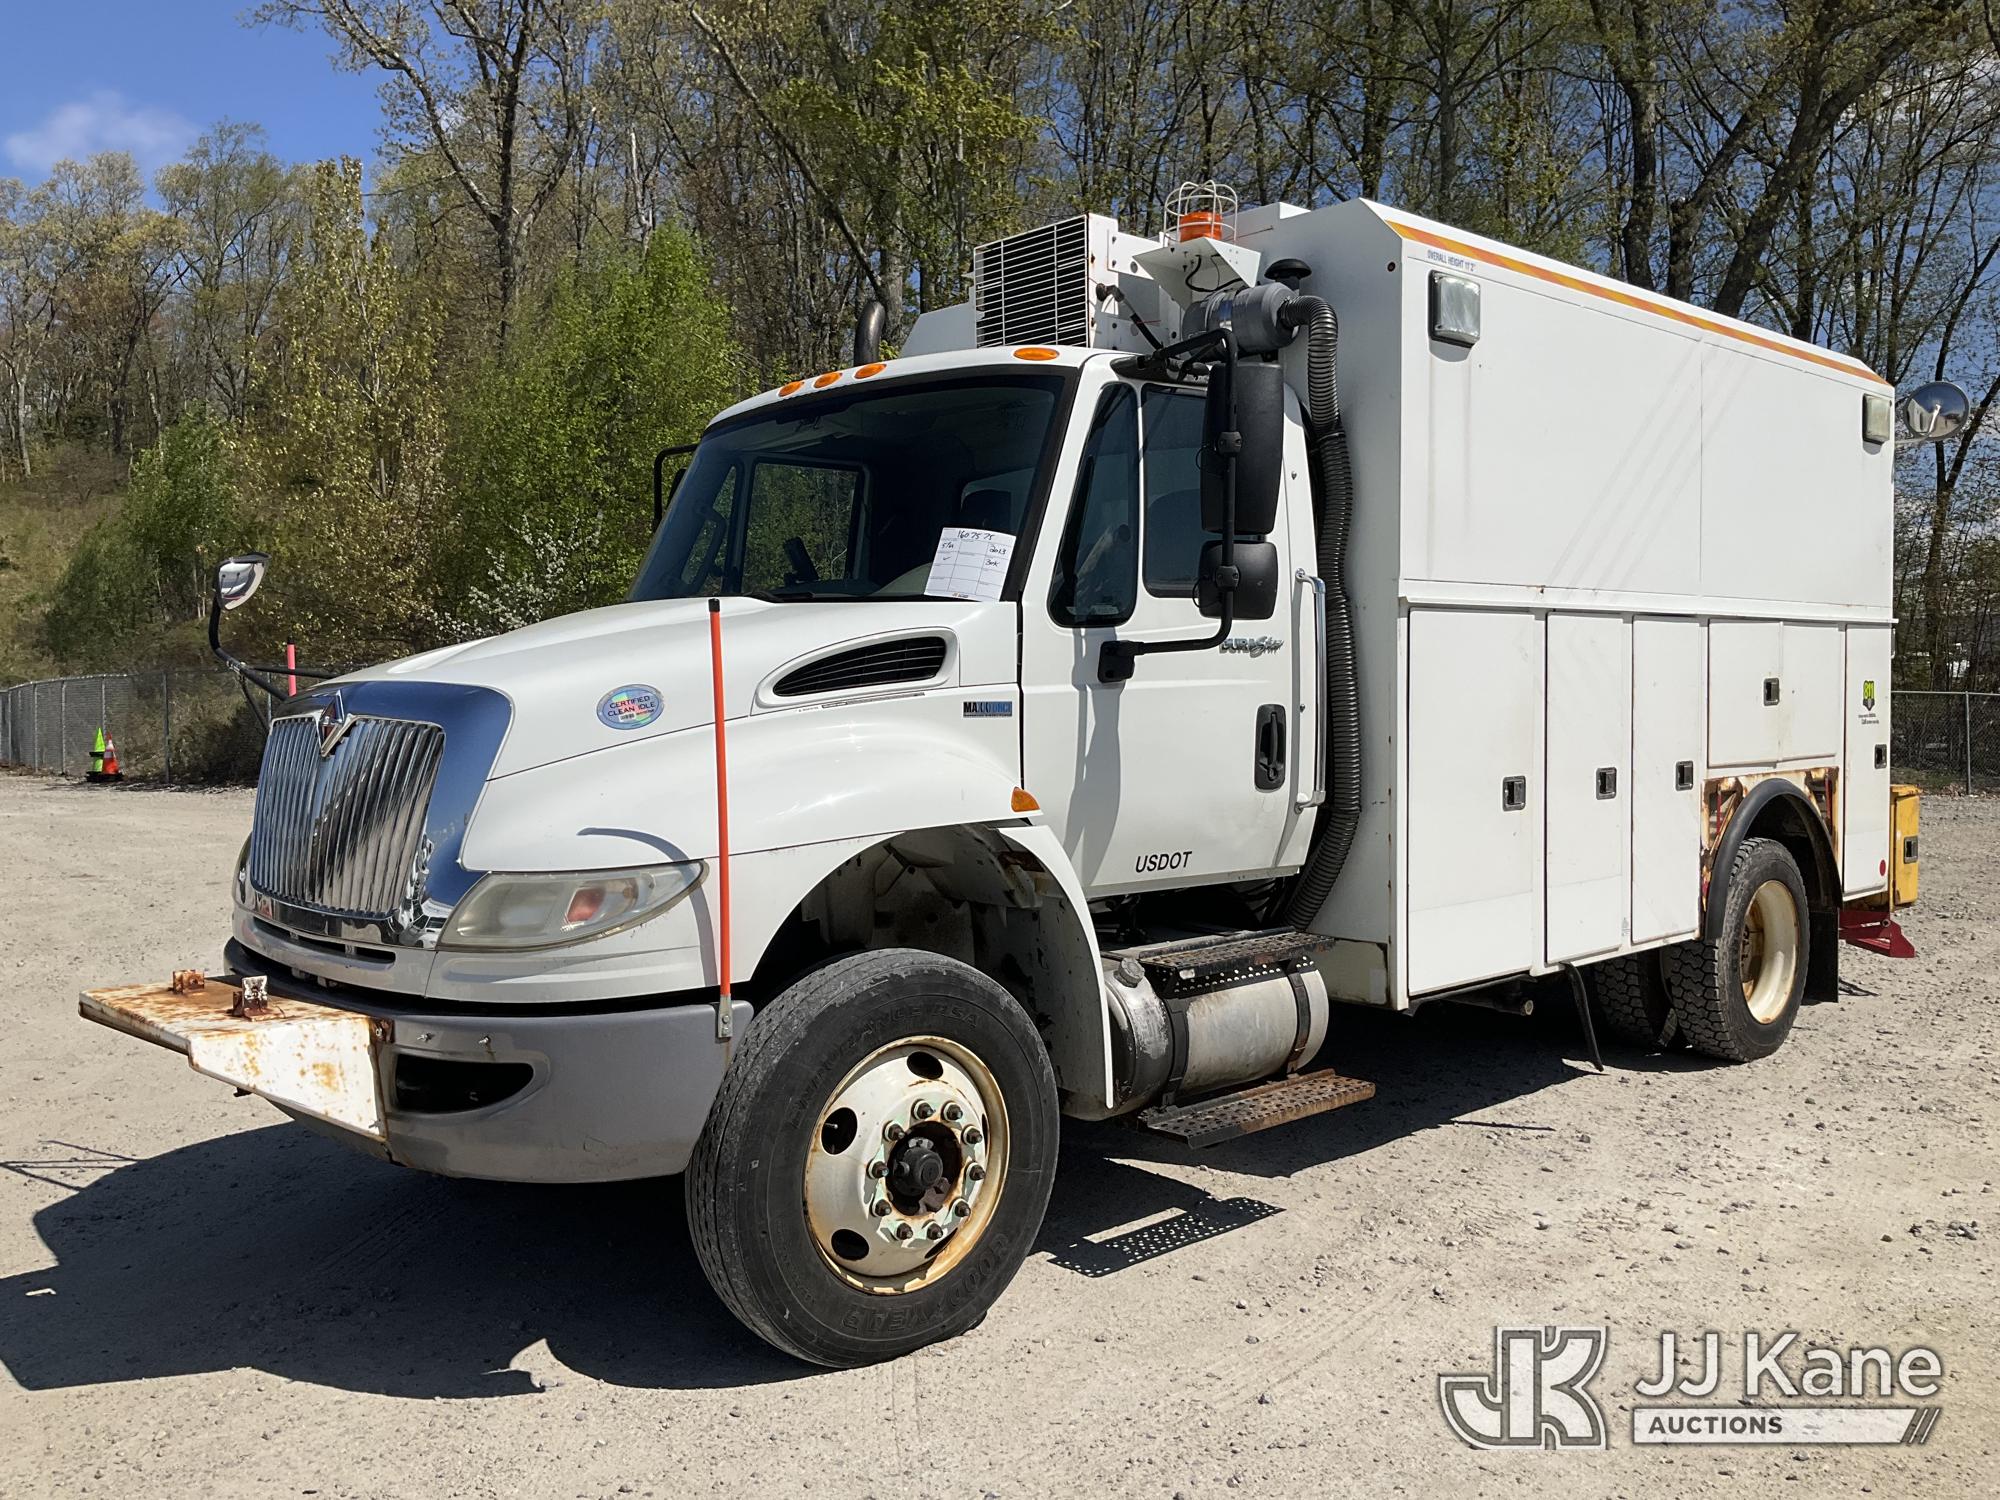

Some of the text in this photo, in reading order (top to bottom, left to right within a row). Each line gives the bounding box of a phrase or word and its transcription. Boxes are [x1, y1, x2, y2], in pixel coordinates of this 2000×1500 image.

[1427, 249, 1448, 264] OVERALL
[1447, 256, 1464, 269] HEIGHT
[608, 706, 635, 717] CLEAN
[638, 702, 656, 711] IDLE
[609, 695, 650, 709] CERTIFIED
[1135, 851, 1193, 873] USDOT
